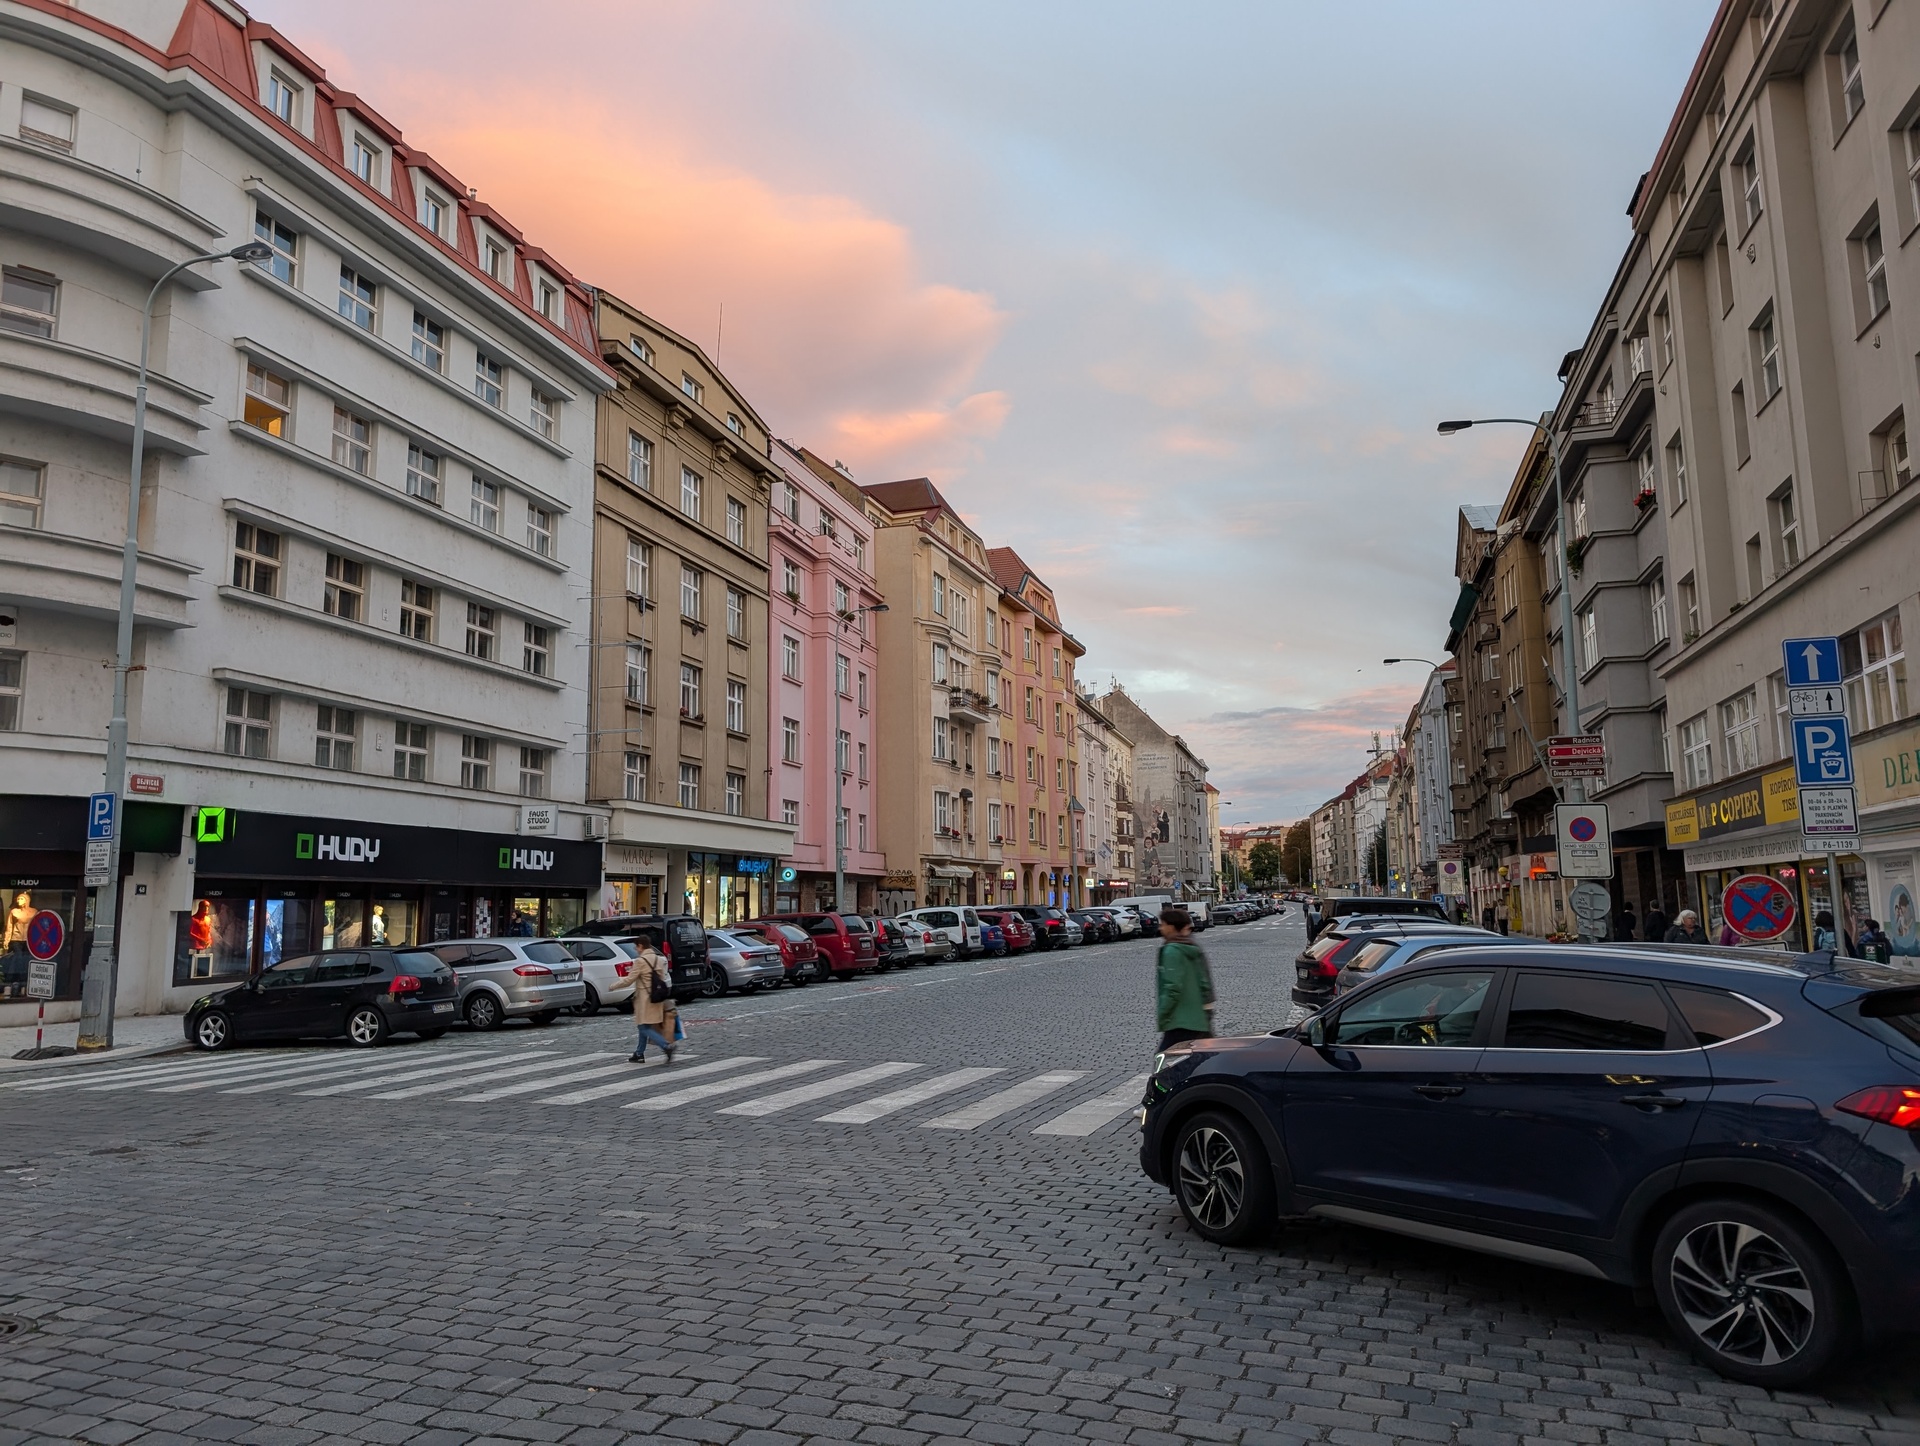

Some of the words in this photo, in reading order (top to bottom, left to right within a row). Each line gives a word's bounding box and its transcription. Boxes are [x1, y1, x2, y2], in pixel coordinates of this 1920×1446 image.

[1804, 726, 1837, 764] P
[1571, 747, 1601, 756] Dejvická
[1553, 769, 1573, 777] Divadlo
[1769, 776, 1798, 796] KOPÍROV
[1720, 789, 1762, 824] COPIER
[1782, 797, 1798, 812] TISK
[94, 798, 110, 825] P
[528, 810, 549, 818] FAUST
[1815, 811, 1843, 819] PARKOVACÍM
[527, 817, 550, 825] STUDIO
[317, 834, 381, 863] HUDY
[1822, 841, 1853, 849] P6-1139
[512, 849, 554, 871] HUDY
[744, 860, 769, 872] HUSKY
[635, 866, 654, 874] STUDIO
